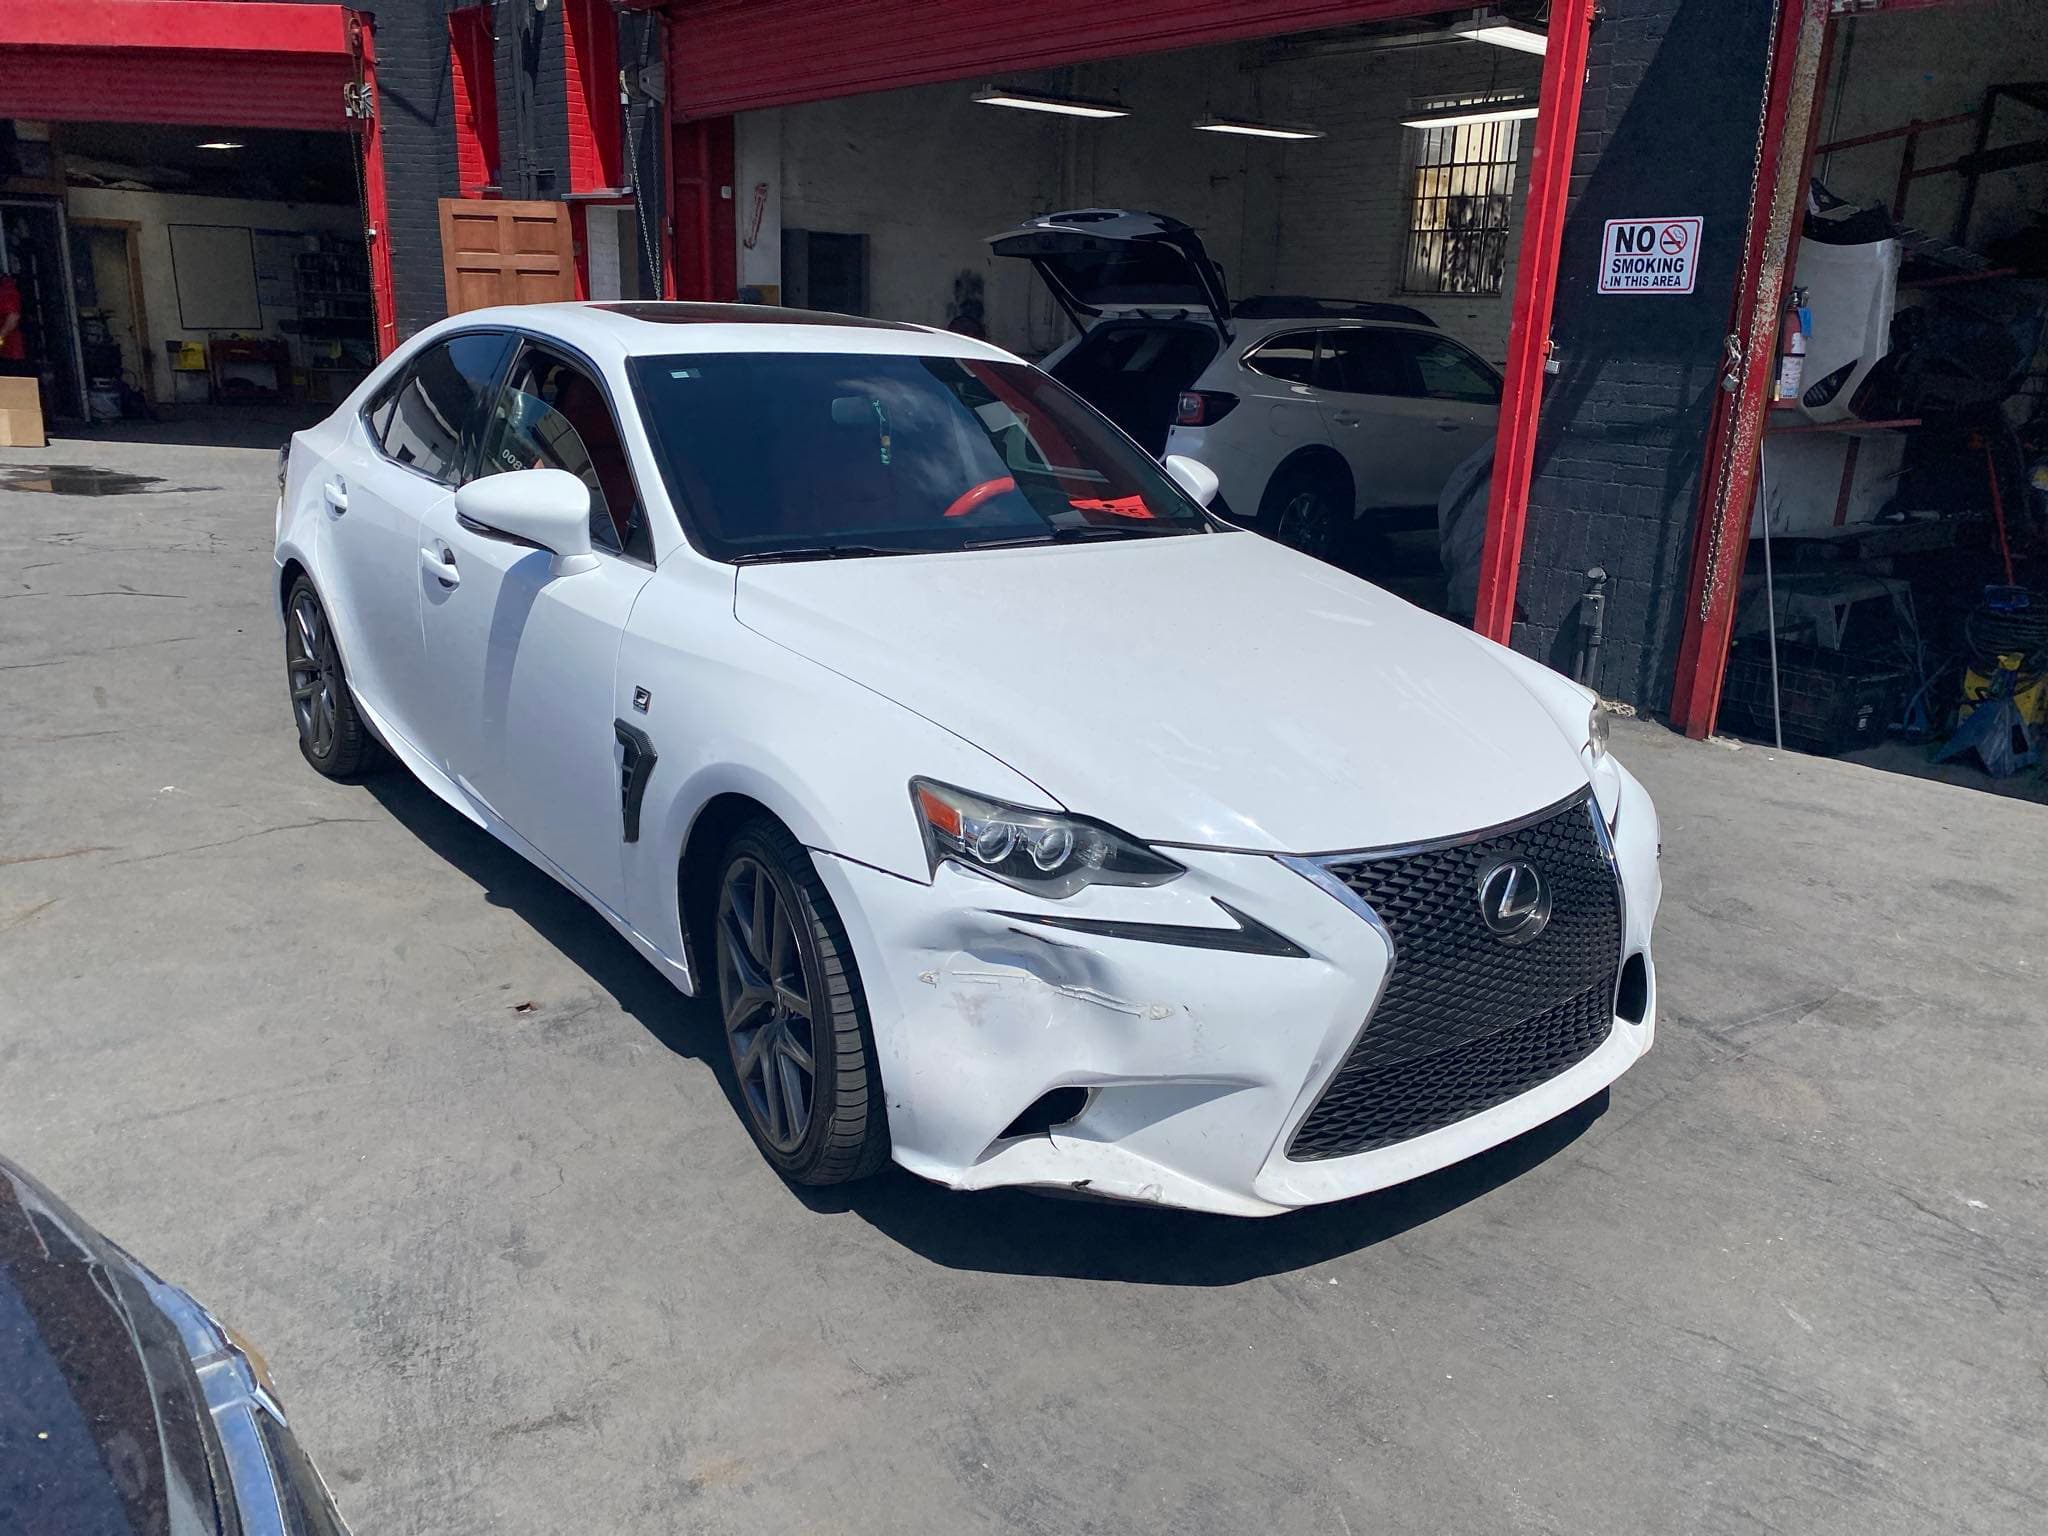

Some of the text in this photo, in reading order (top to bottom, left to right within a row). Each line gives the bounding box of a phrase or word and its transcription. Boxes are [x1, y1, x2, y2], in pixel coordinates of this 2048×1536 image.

[1615, 225, 1656, 253] NO
[1611, 258, 1684, 274] SMOKING
[1610, 275, 1681, 287] IN THIS AREA
